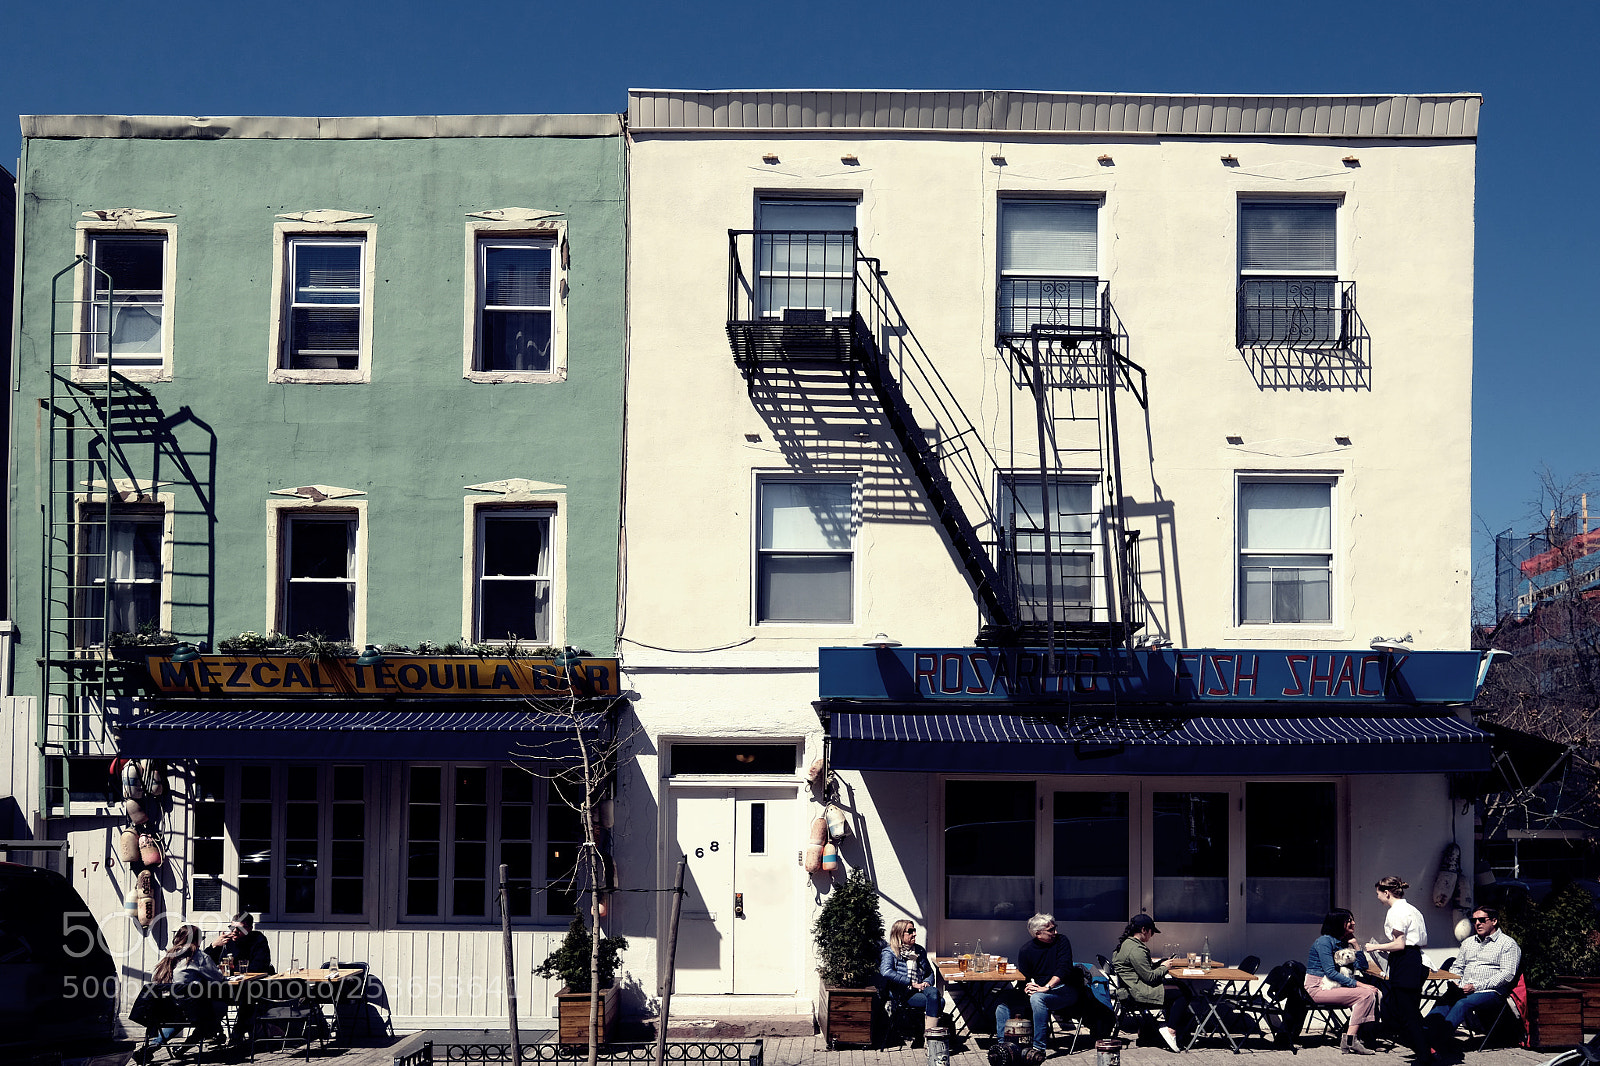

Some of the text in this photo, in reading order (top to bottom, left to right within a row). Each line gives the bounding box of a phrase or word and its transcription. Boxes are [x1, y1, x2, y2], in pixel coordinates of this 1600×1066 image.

[159, 661, 610, 692] MEZCAL TEQUILA BAR
[913, 652, 1410, 698] ROSARITO FISH SHACK
[80, 857, 115, 879] 170
